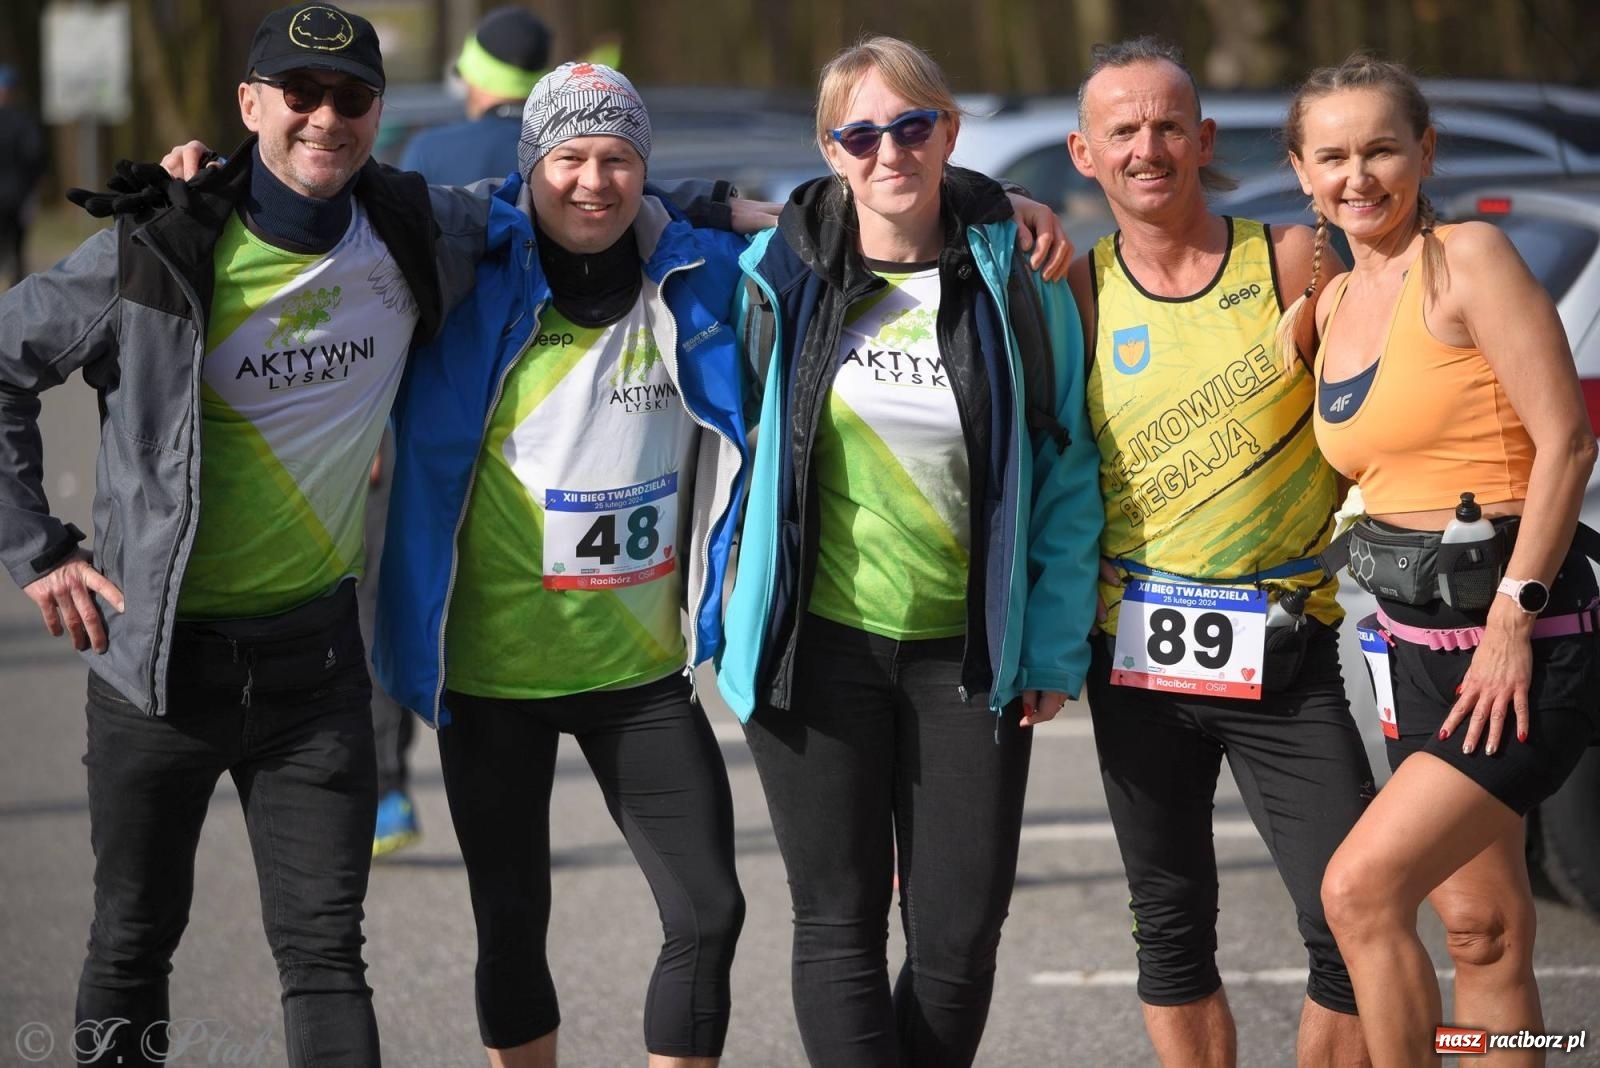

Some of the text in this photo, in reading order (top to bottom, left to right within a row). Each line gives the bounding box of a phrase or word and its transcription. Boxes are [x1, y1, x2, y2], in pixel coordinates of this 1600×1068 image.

[1219, 283, 1261, 310] deep
[235, 336, 374, 379] AKTYWNI
[269, 365, 349, 390] LYSKI
[625, 400, 669, 413] LYSKI
[1120, 418, 1261, 528] BIEGAJĄ
[563, 478, 666, 503] XII BIEG TWARDZIELA
[605, 501, 626, 510] lutego
[576, 505, 659, 565] 48
[590, 576, 631, 585] Racibórz
[1138, 582, 1249, 602] XII BIEG TWARDZIELA
[1173, 597, 1197, 606] lutego
[1147, 608, 1233, 669] 89
[1156, 676, 1197, 689] Racibórz
